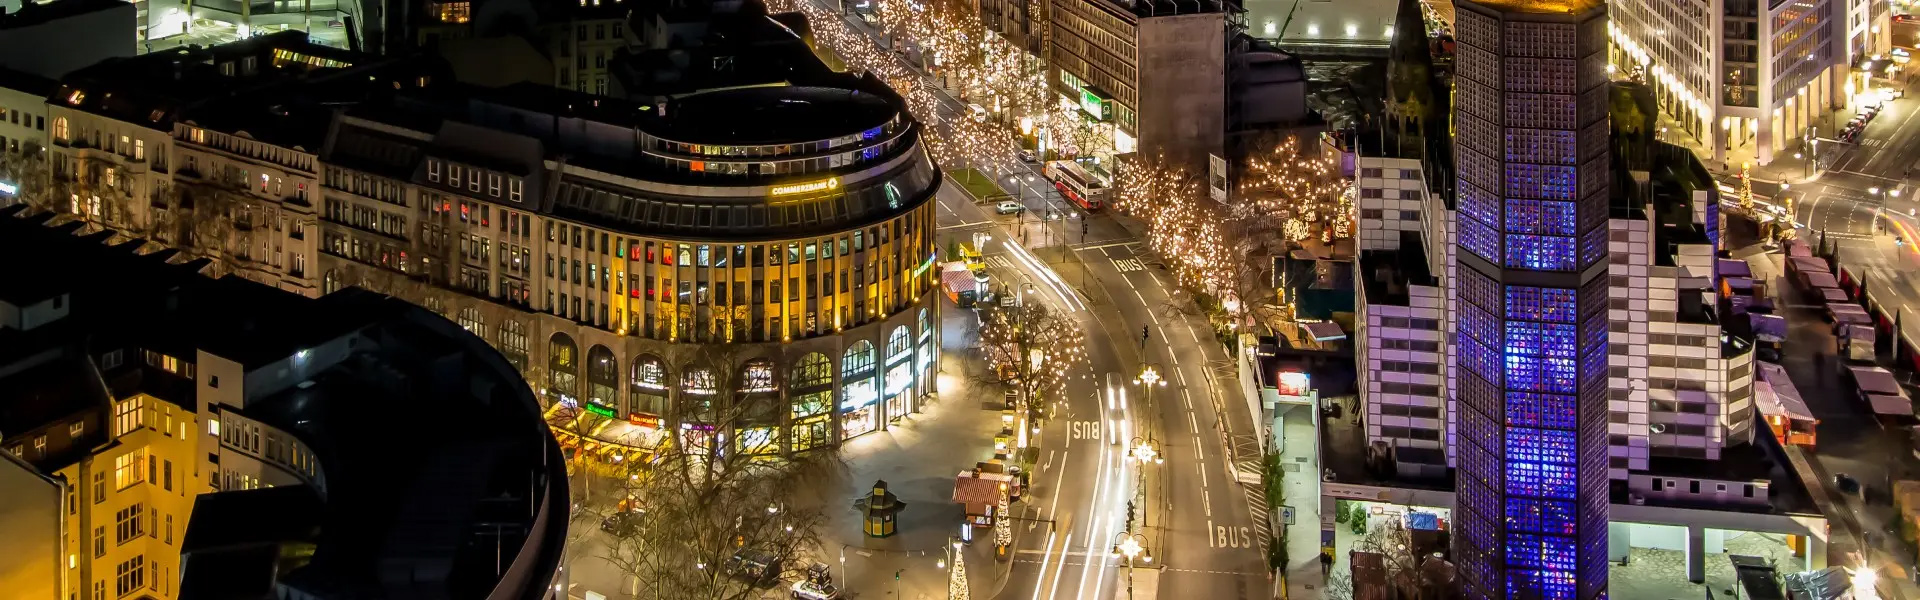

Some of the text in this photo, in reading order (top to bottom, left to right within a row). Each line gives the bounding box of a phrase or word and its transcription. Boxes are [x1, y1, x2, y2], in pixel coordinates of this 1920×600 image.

[772, 182, 828, 196] COMMERZBANK
[1115, 258, 1143, 272] BUS
[1073, 420, 1100, 440] BUS
[1217, 525, 1251, 549] BUS
